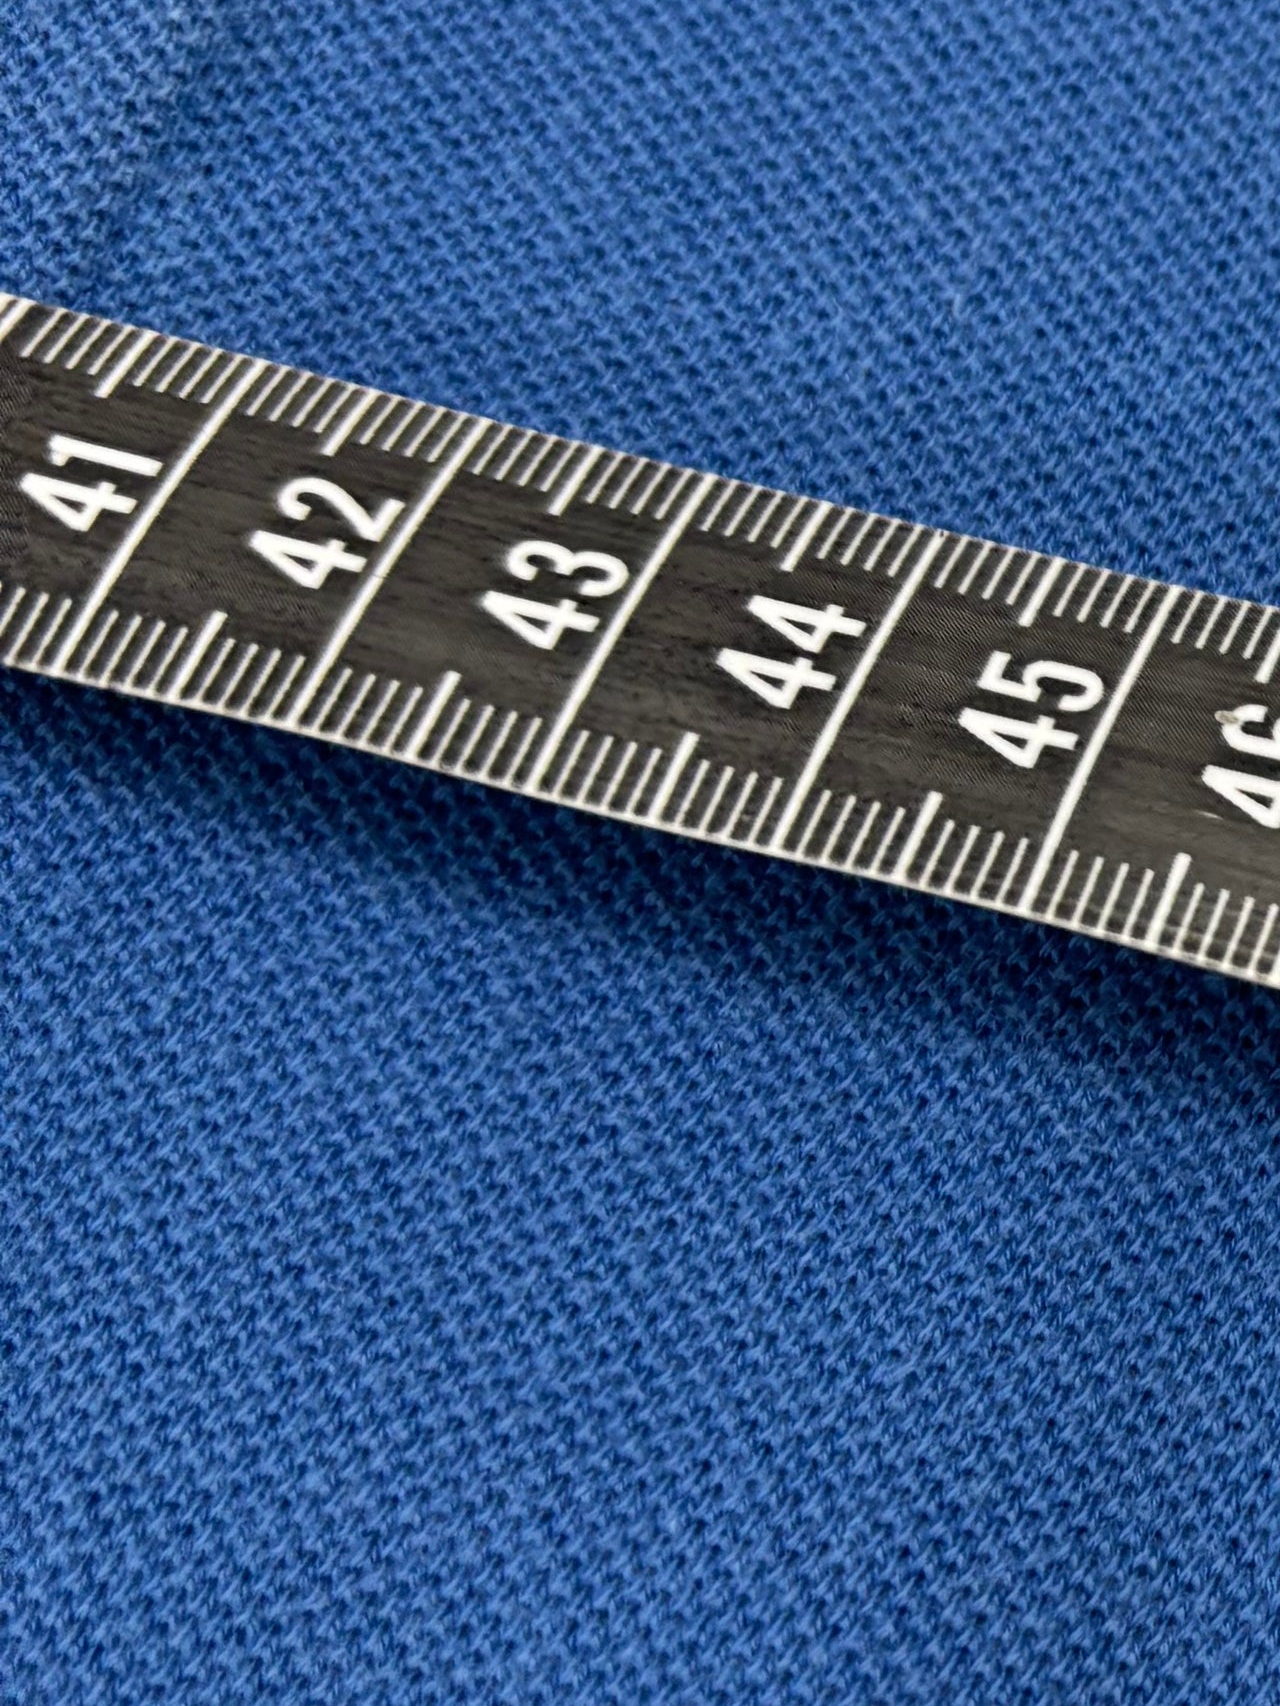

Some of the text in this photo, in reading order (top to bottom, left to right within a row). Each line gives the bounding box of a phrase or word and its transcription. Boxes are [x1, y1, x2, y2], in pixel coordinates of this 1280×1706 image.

[20, 434, 163, 533] 41
[250, 477, 406, 589] 42
[480, 540, 628, 649] 43
[716, 595, 866, 709] 44
[959, 650, 1104, 769] 45
